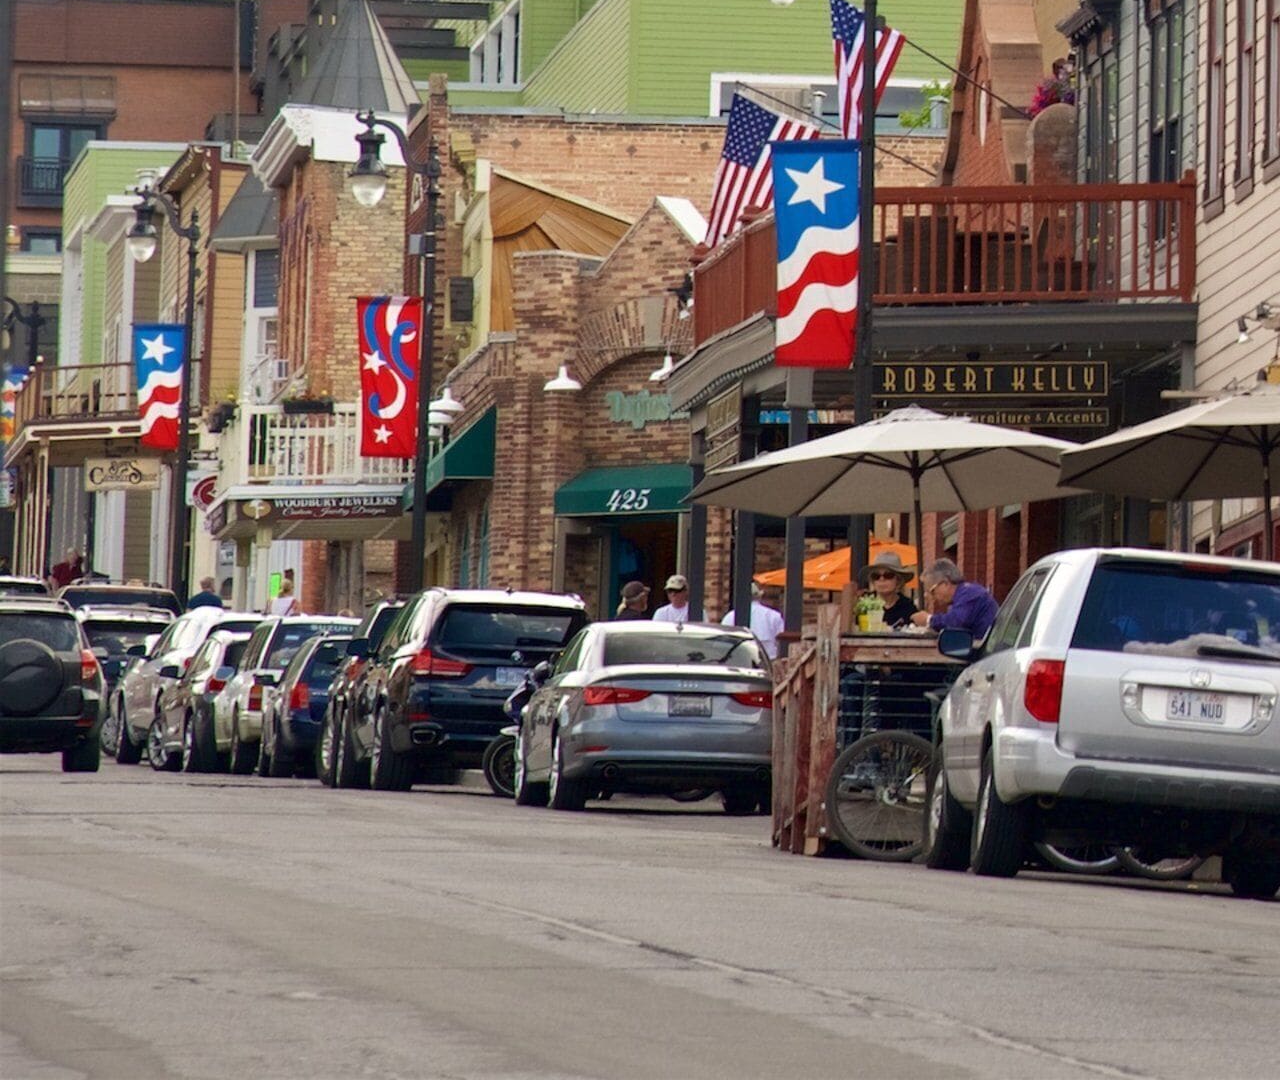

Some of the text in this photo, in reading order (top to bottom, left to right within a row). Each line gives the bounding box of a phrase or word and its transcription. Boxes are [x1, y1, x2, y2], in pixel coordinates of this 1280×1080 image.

[882, 366, 1096, 392] ROBERT KELLY
[274, 496, 398, 508] WOODBURY JEWELERS
[607, 489, 651, 512] 425
[1171, 702, 1192, 716] 541
